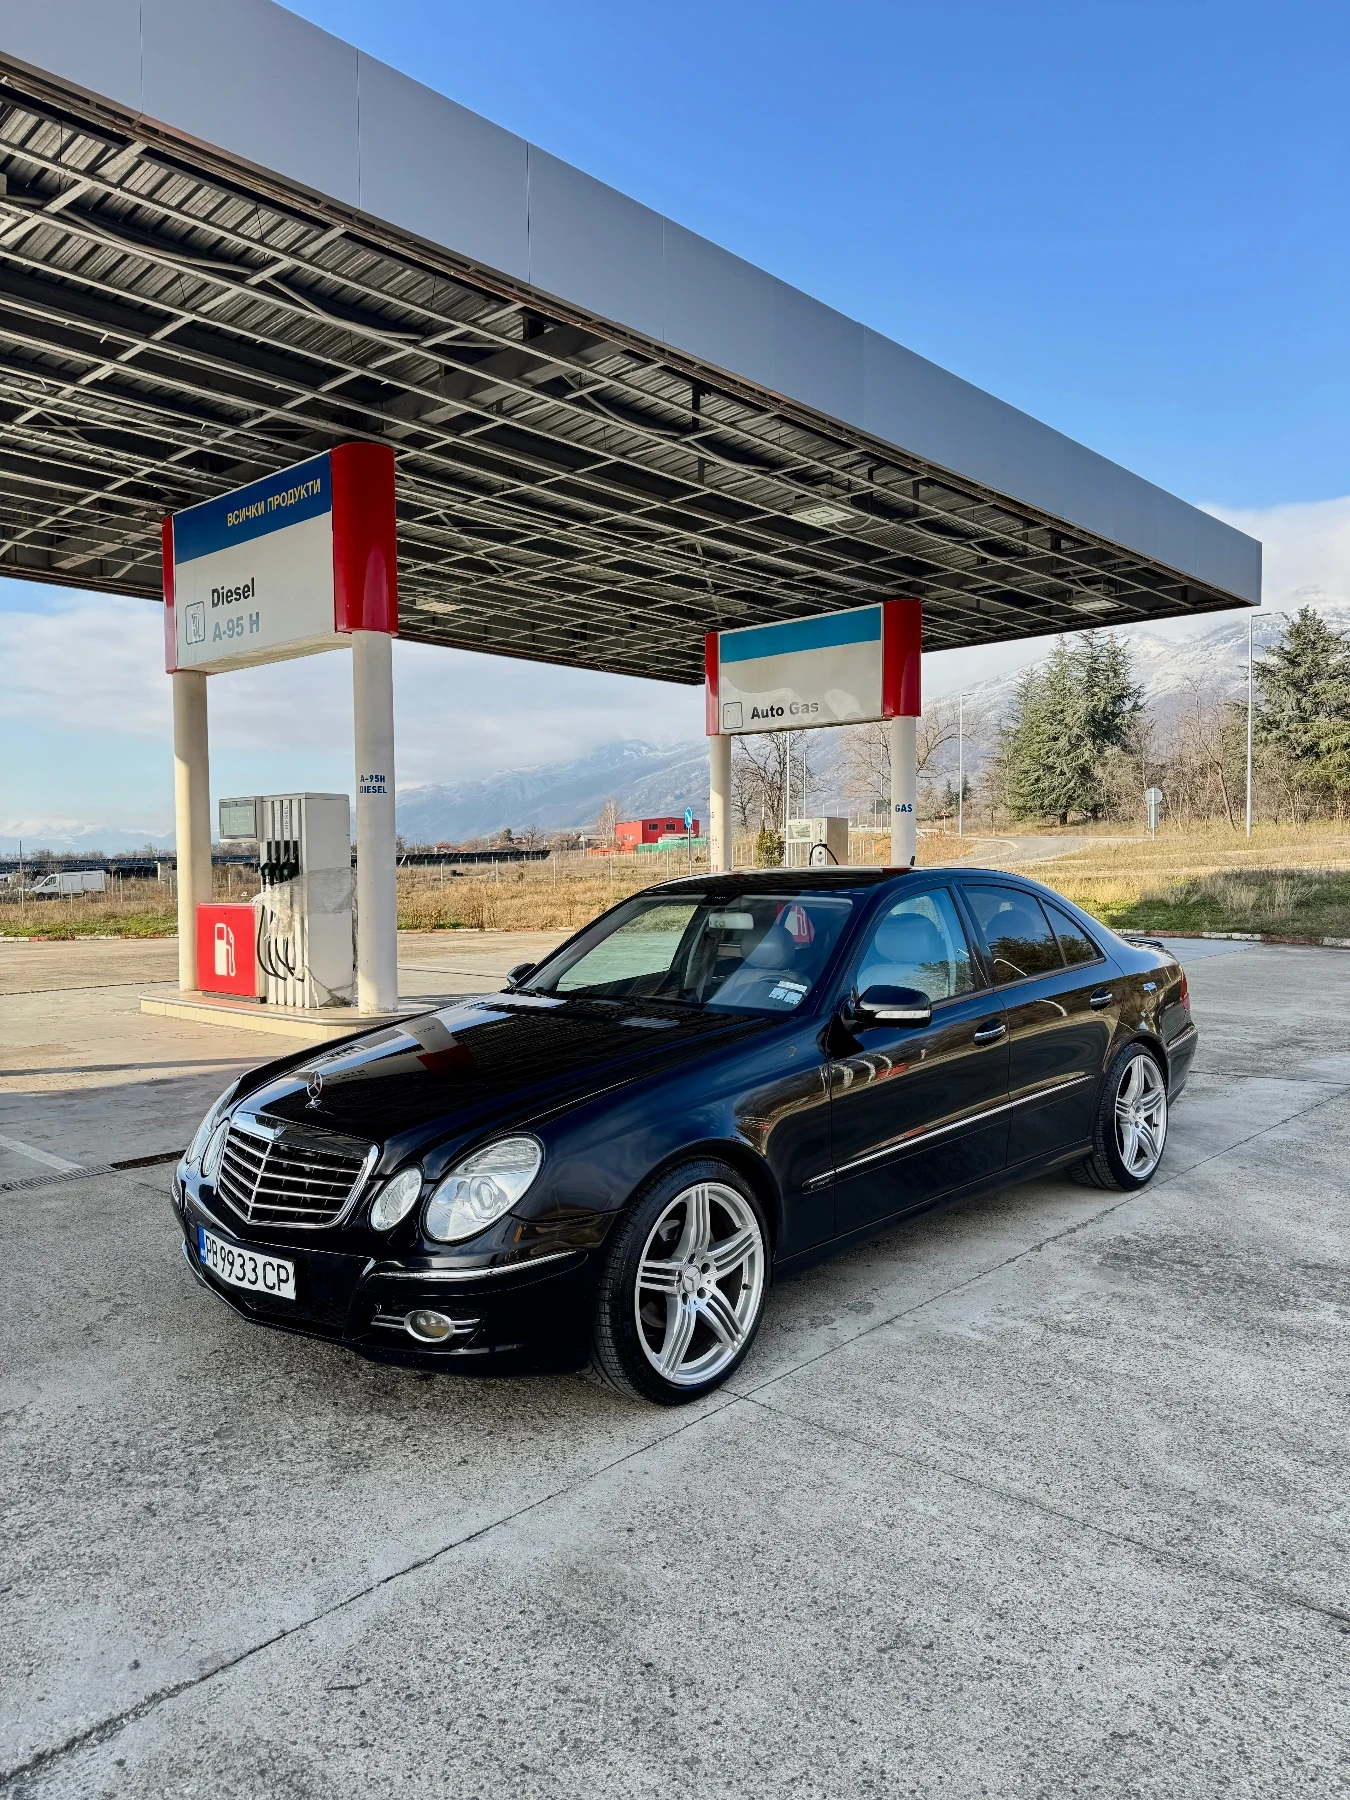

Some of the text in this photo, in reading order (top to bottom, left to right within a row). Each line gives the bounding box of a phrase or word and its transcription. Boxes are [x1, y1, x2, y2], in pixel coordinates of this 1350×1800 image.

[227, 478, 321, 527] ВСИЧКИ ПРОДУКТИ
[211, 577, 255, 609] Diesel
[212, 615, 244, 643] A-95
[750, 701, 819, 720] Auto Gas
[360, 774, 386, 783] A-95H
[359, 785, 388, 794] DIESEL
[895, 803, 913, 813] GAS
